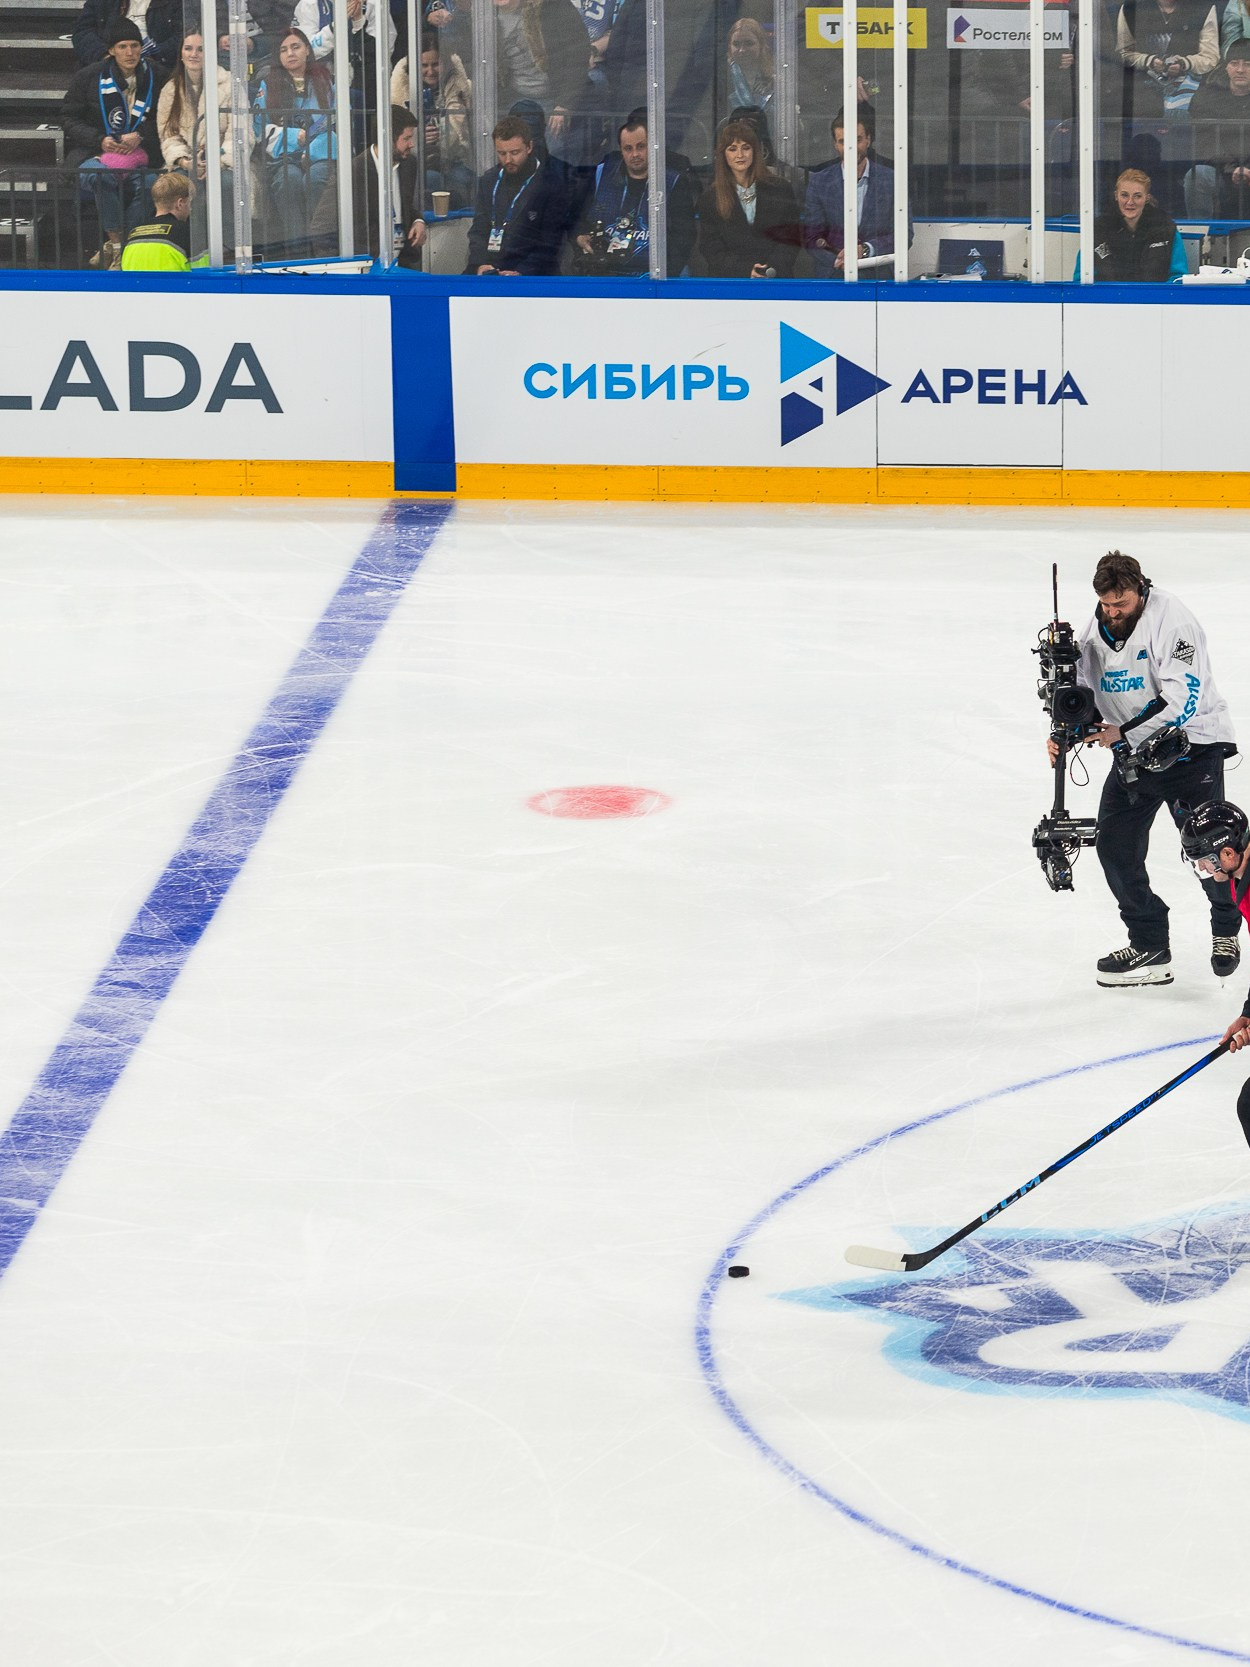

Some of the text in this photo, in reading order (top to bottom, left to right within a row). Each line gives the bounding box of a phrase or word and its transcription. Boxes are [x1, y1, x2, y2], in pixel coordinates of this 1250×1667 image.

[972, 28, 1063, 41] Ростелеом
[523, 362, 750, 401] СИБИРЬ
[901, 368, 1089, 406] АРЕНА
[1212, 835, 1230, 847] CCM
[981, 1174, 1042, 1223] CCM
